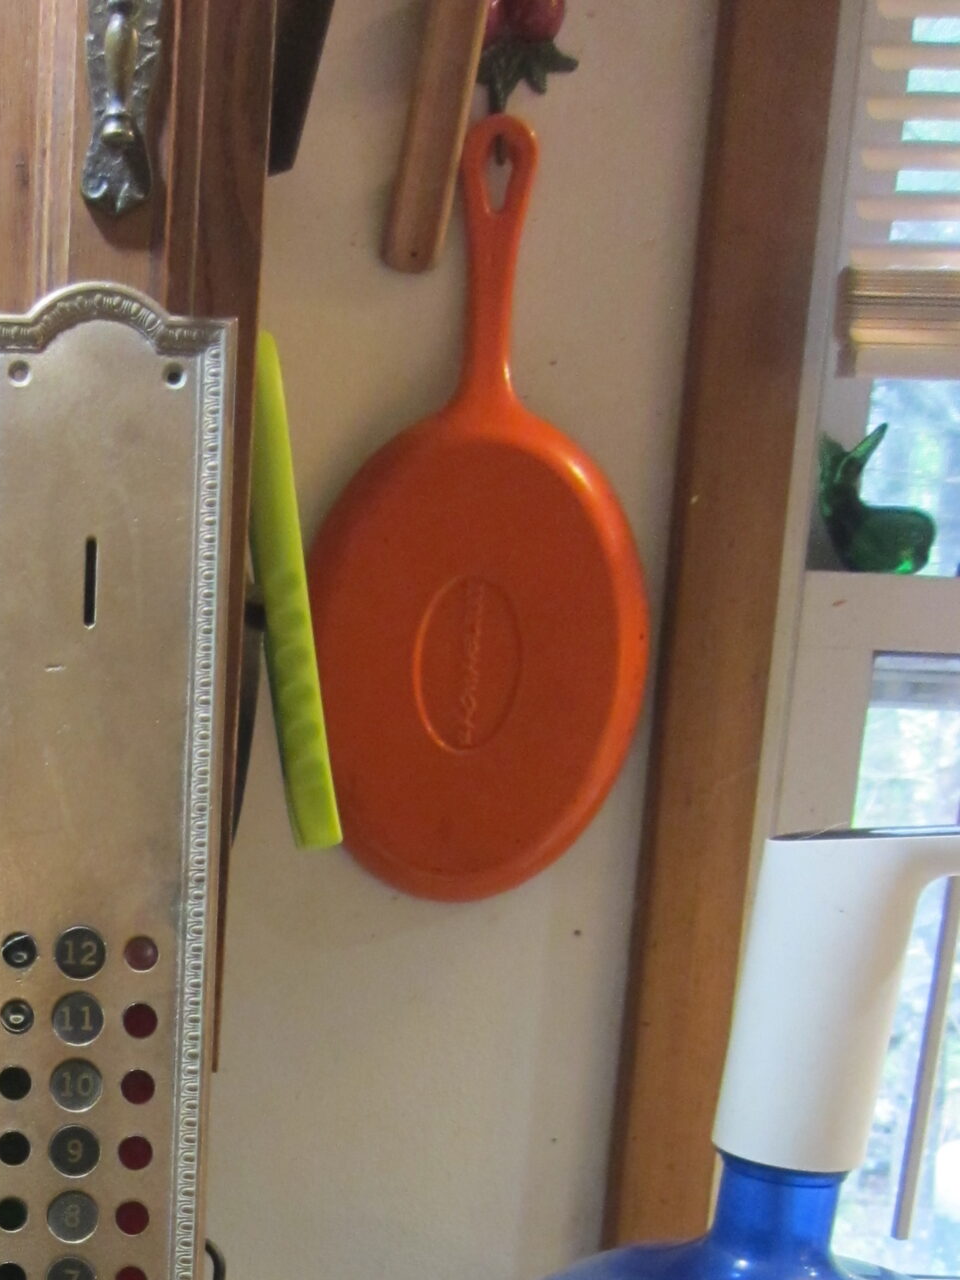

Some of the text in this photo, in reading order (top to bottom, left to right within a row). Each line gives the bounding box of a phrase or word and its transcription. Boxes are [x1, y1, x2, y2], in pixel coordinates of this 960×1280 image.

[62, 940, 97, 966] 12
[61, 1005, 94, 1032] 11
[61, 1071, 94, 1098] 10
[65, 1138, 83, 1163] 9
[64, 1204, 81, 1228] 8
